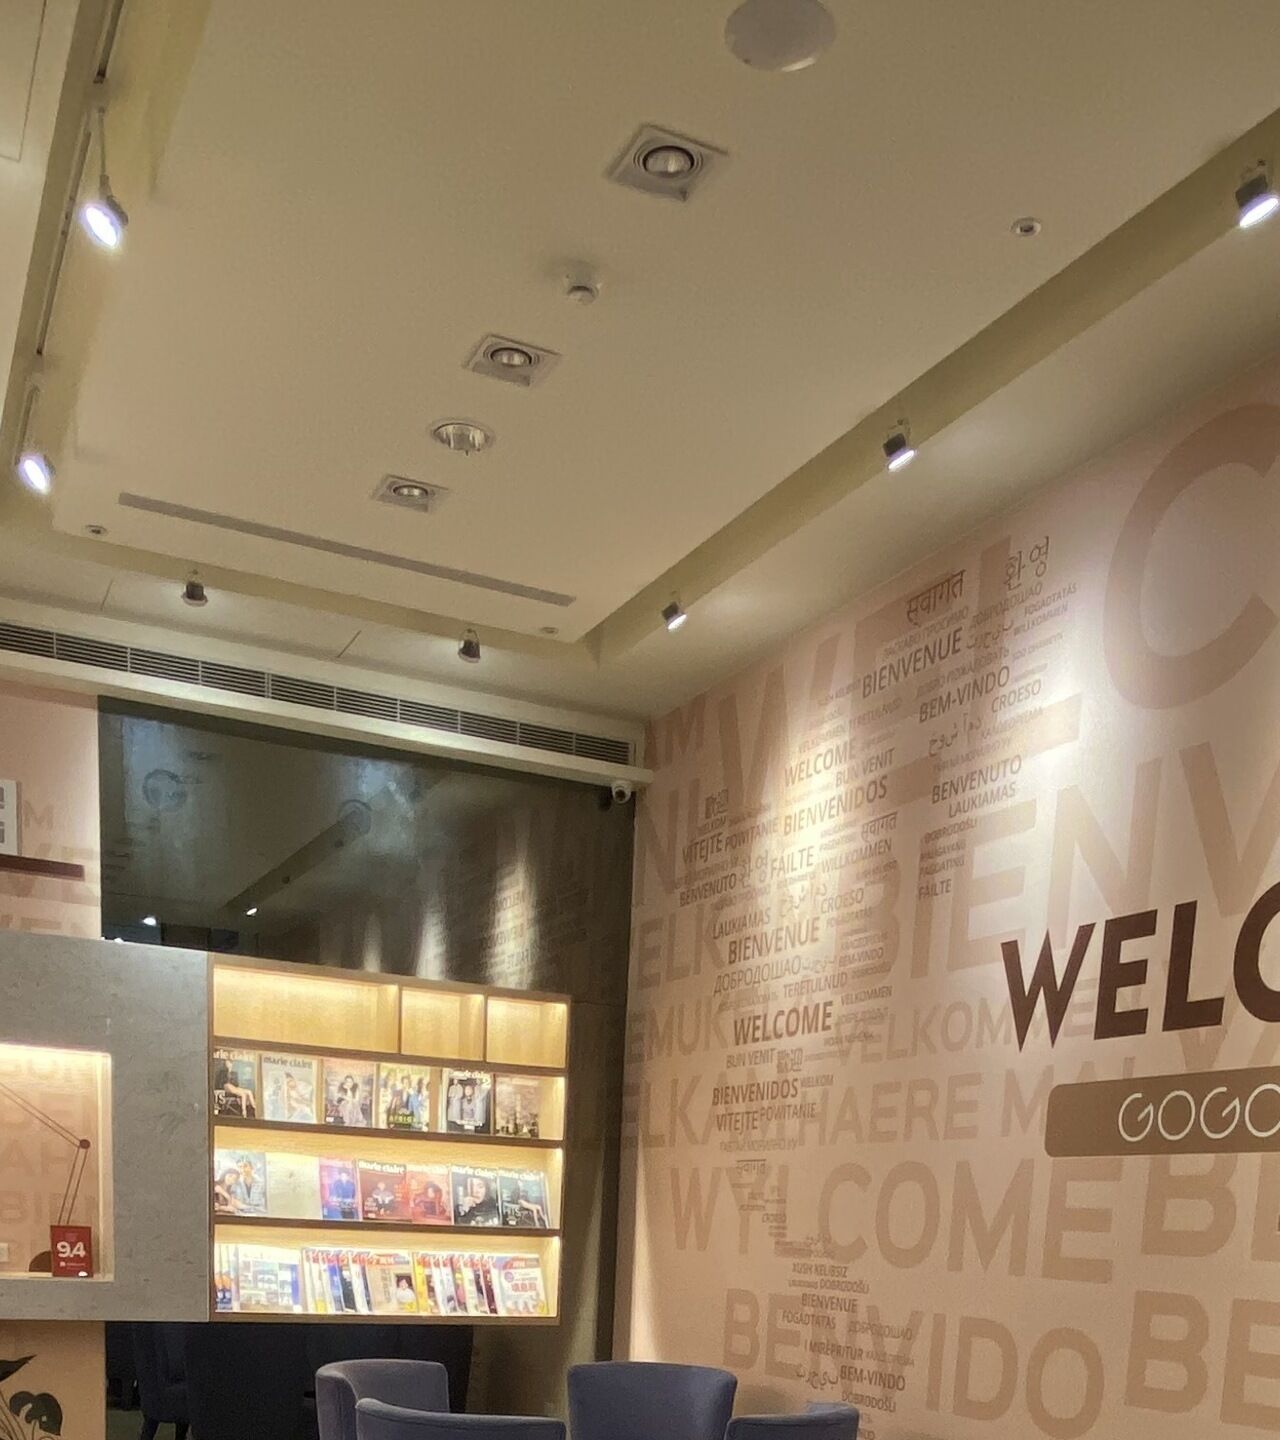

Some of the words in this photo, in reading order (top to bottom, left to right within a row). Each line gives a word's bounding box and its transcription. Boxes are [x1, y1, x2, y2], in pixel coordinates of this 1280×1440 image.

[862, 627, 963, 699] BIENVENUE
[919, 665, 1010, 724] BEM-VINDO
[992, 679, 1042, 714] CROESO
[784, 738, 856, 787] WELCOME
[862, 747, 895, 777] VENIT
[931, 754, 1022, 805] BENVENUTO
[783, 775, 888, 837] BIENVENIDOS
[948, 781, 1016, 818] LAUKIAMAS
[728, 917, 820, 965] BIENVENUE
[734, 1001, 834, 1046] WELCOME
[712, 1077, 799, 1107] BIENVENIDOS
[840, 1365, 906, 1391] BEM-VINDO
